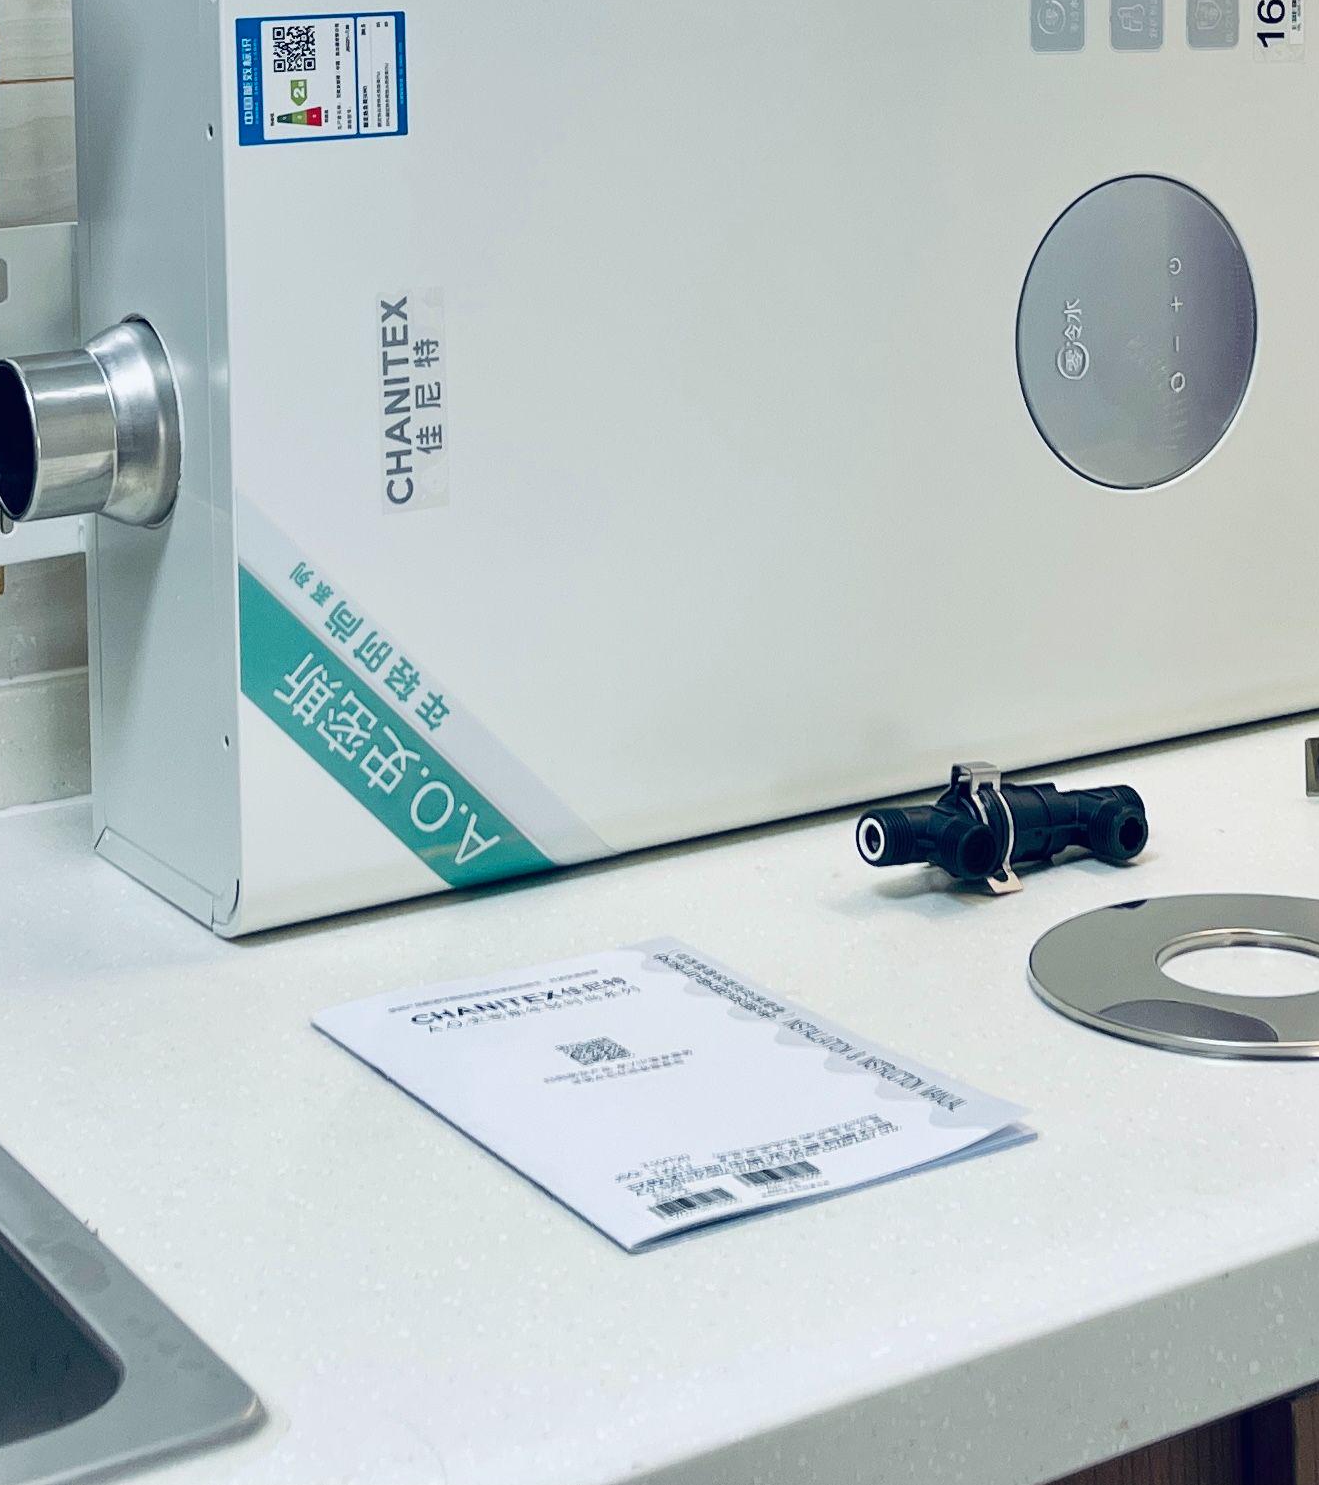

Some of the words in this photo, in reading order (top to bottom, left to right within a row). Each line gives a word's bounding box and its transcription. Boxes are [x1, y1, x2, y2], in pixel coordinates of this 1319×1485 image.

[381, 296, 414, 504] CHANITEX
[412, 338, 444, 456] 佳尼特
[273, 652, 500, 866] A.O.史密斯
